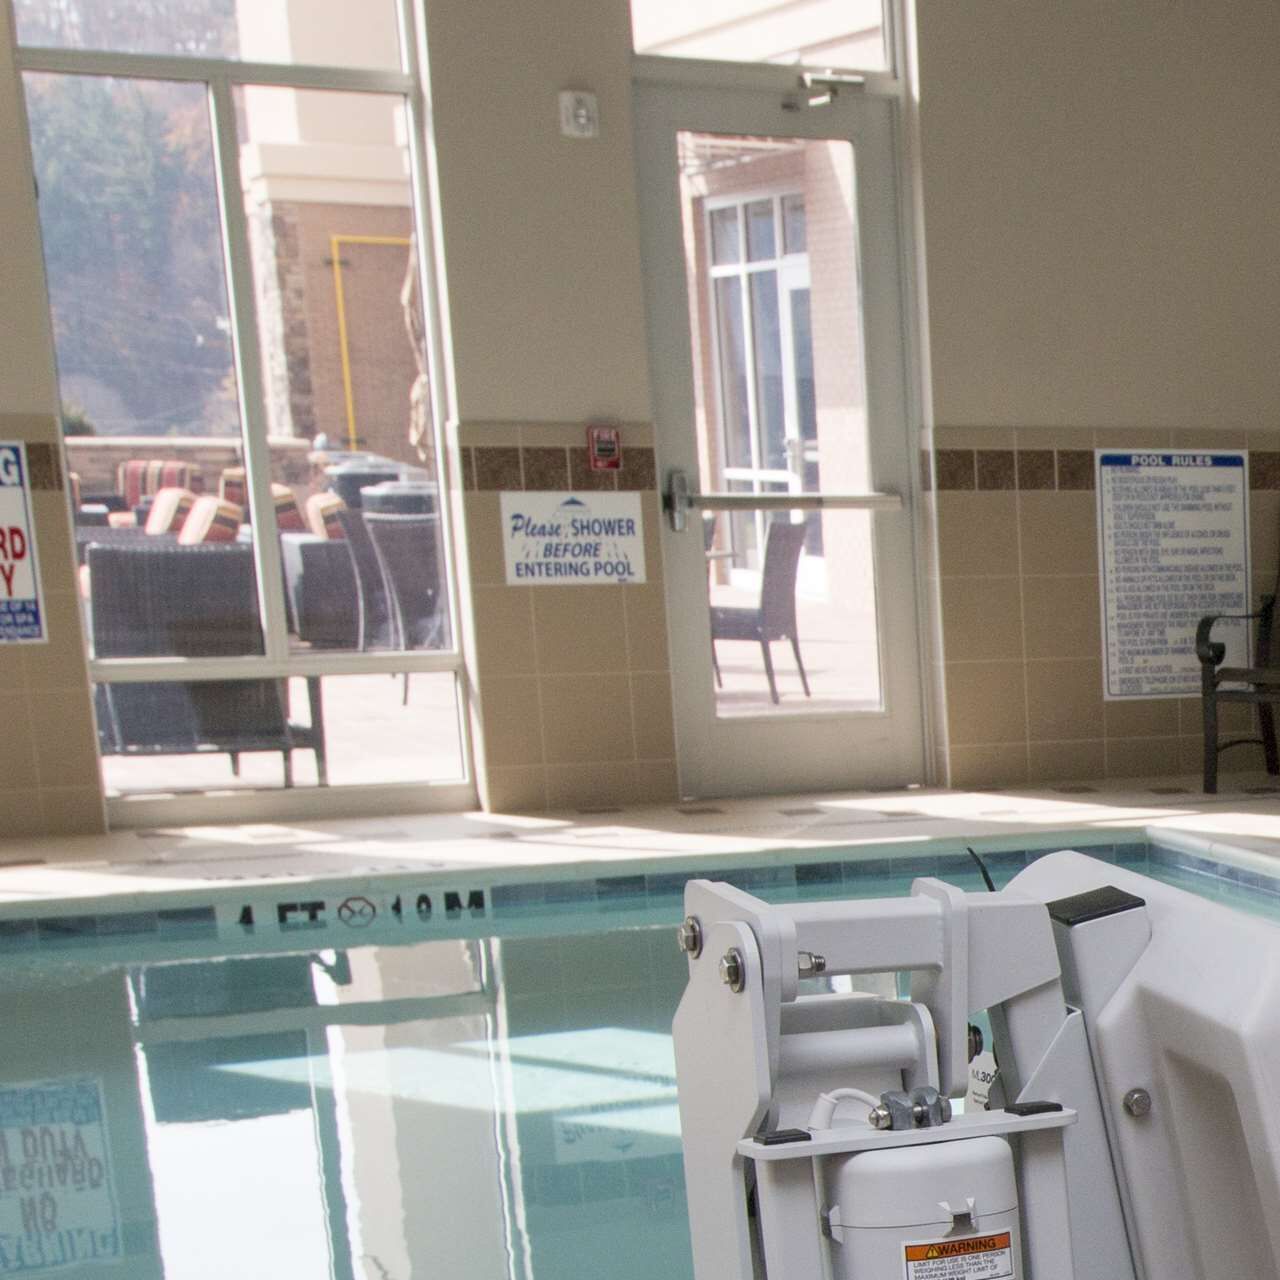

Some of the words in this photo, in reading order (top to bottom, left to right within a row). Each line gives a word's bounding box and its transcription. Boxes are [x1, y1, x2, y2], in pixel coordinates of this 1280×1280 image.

[1131, 454, 1166, 466] POOL
[1171, 454, 1213, 466] RULES
[511, 513, 561, 537] Please
[571, 518, 635, 536] SHOWER
[543, 542, 601, 559] BEFORE
[515, 562, 590, 577] ENTERING
[594, 561, 635, 577] POOL
[939, 1238, 997, 1255] WARNING
